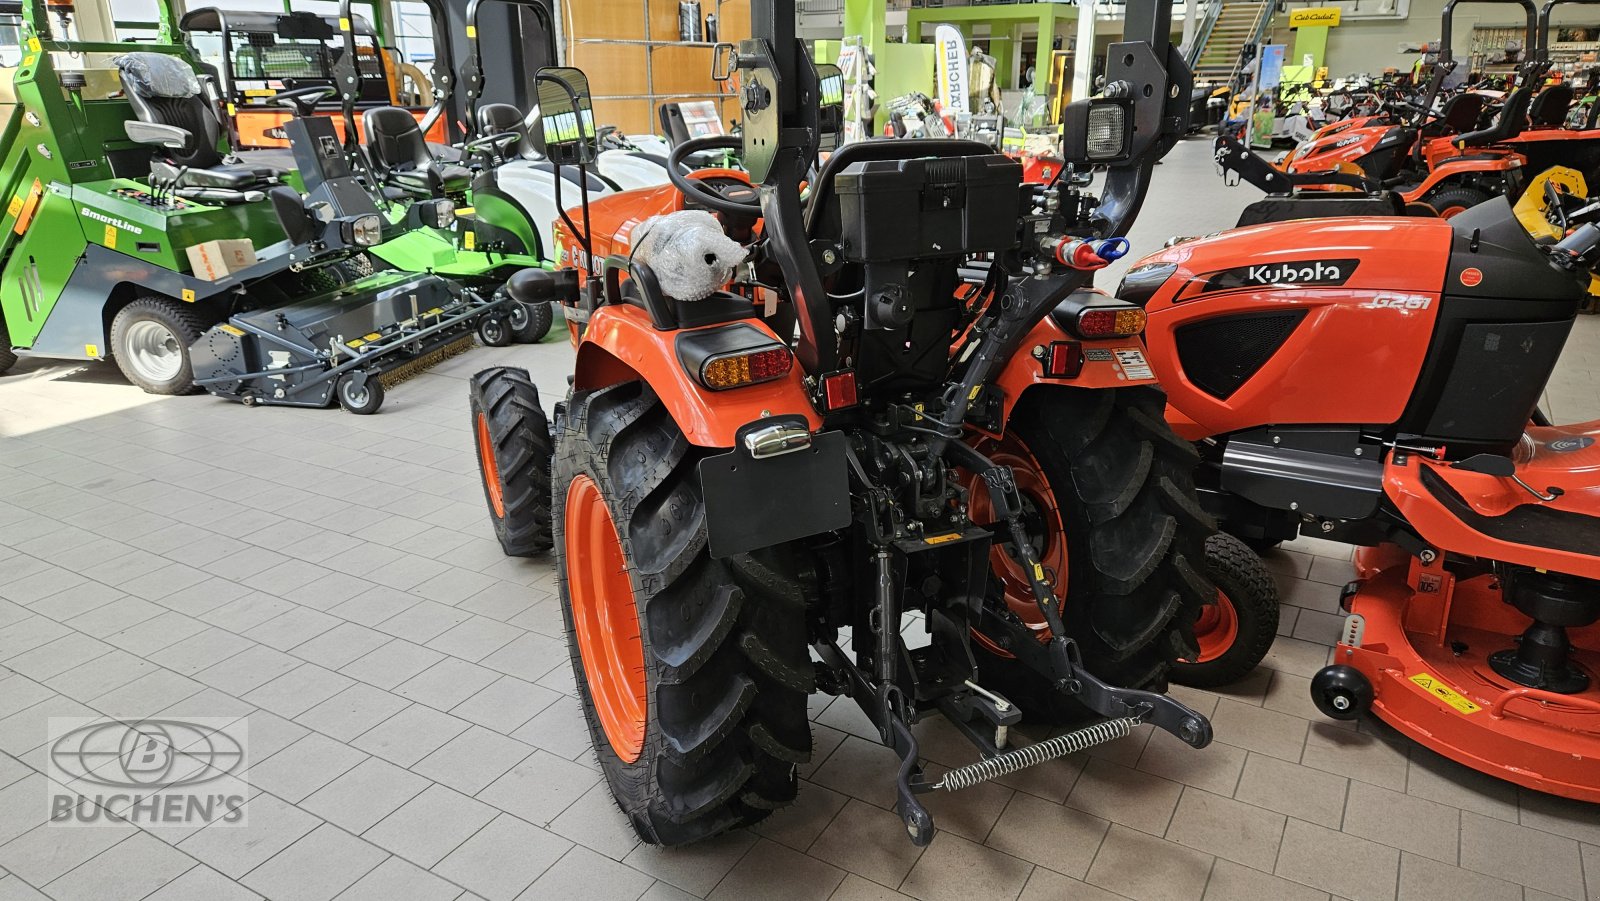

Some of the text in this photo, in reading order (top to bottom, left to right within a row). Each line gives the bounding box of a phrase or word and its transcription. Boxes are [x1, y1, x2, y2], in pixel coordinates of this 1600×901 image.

[81, 207, 143, 235] SmartLine
[1249, 262, 1340, 284] Kubota
[1373, 293, 1432, 310] G261
[1420, 581, 1434, 593] 105
